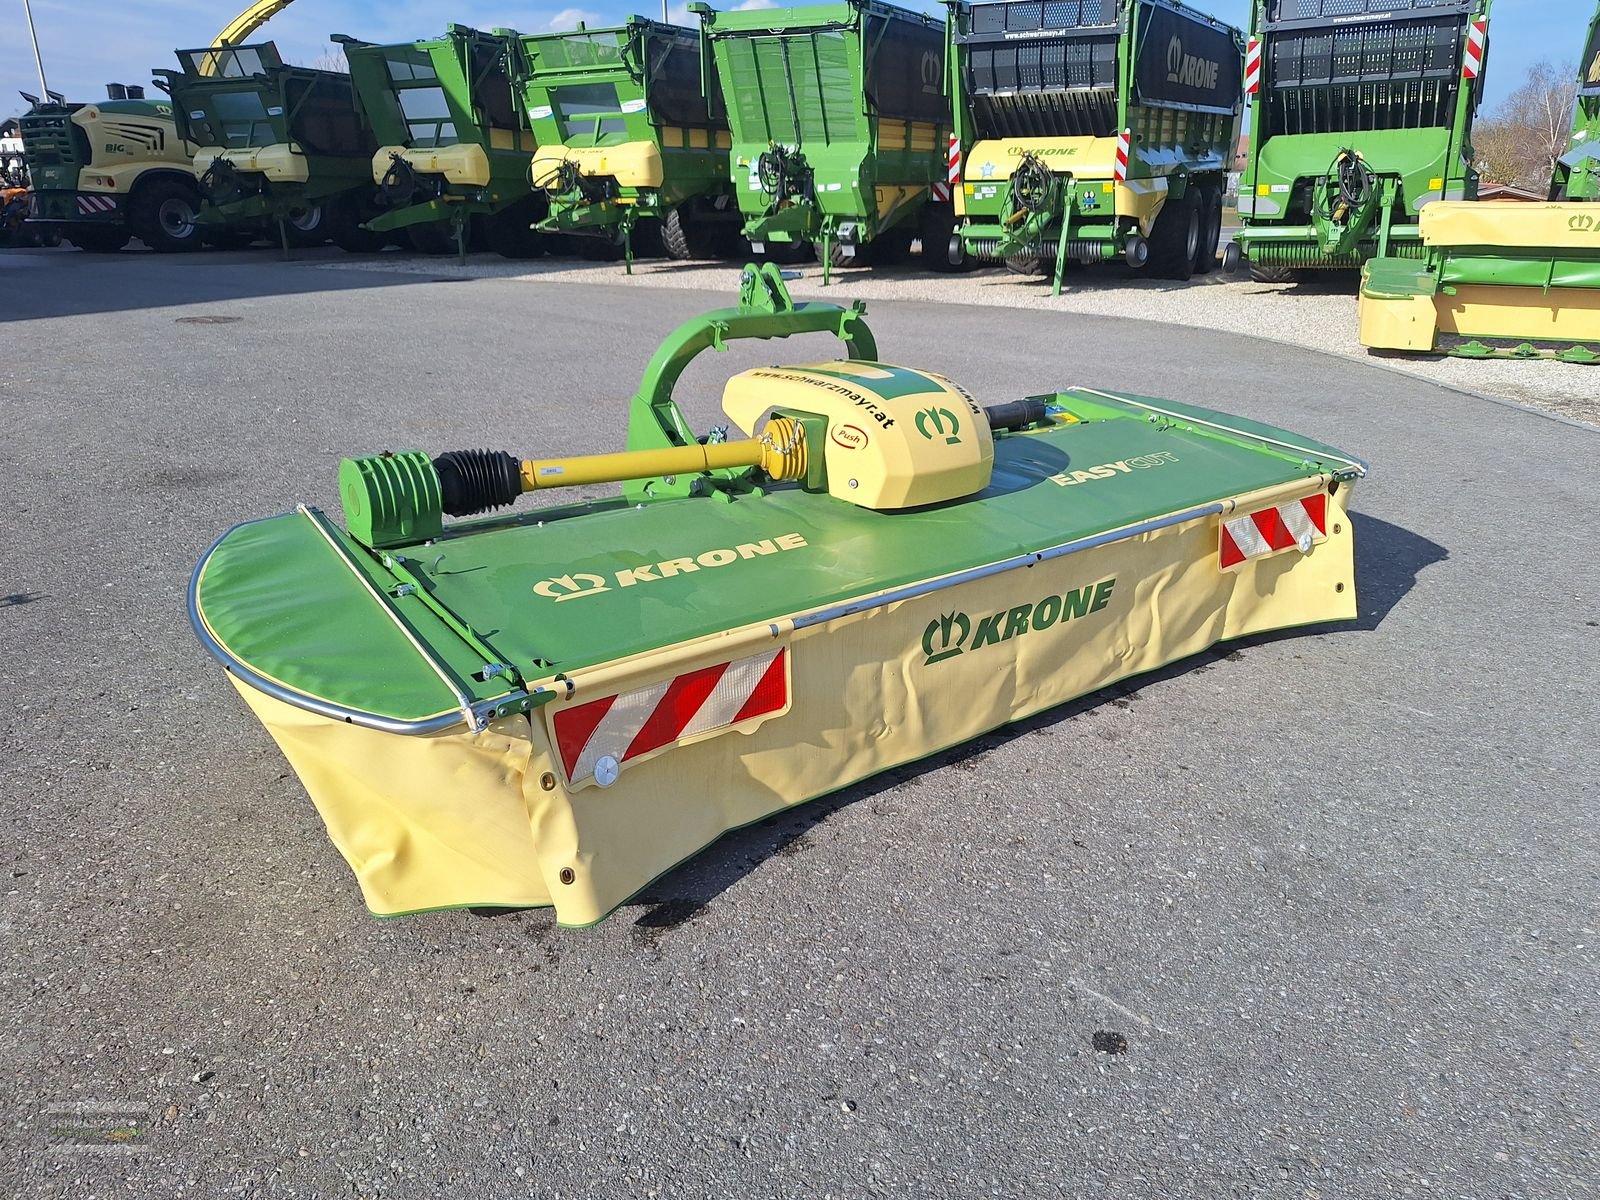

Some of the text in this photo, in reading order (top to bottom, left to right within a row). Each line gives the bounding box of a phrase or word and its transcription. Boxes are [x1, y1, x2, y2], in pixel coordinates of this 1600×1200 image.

[1179, 53, 1219, 90] KRONE
[752, 371, 896, 430] www.schwarzmayr.at
[838, 430, 861, 443] Push
[614, 532, 809, 588] KRONE
[969, 578, 1117, 651] KRONE
